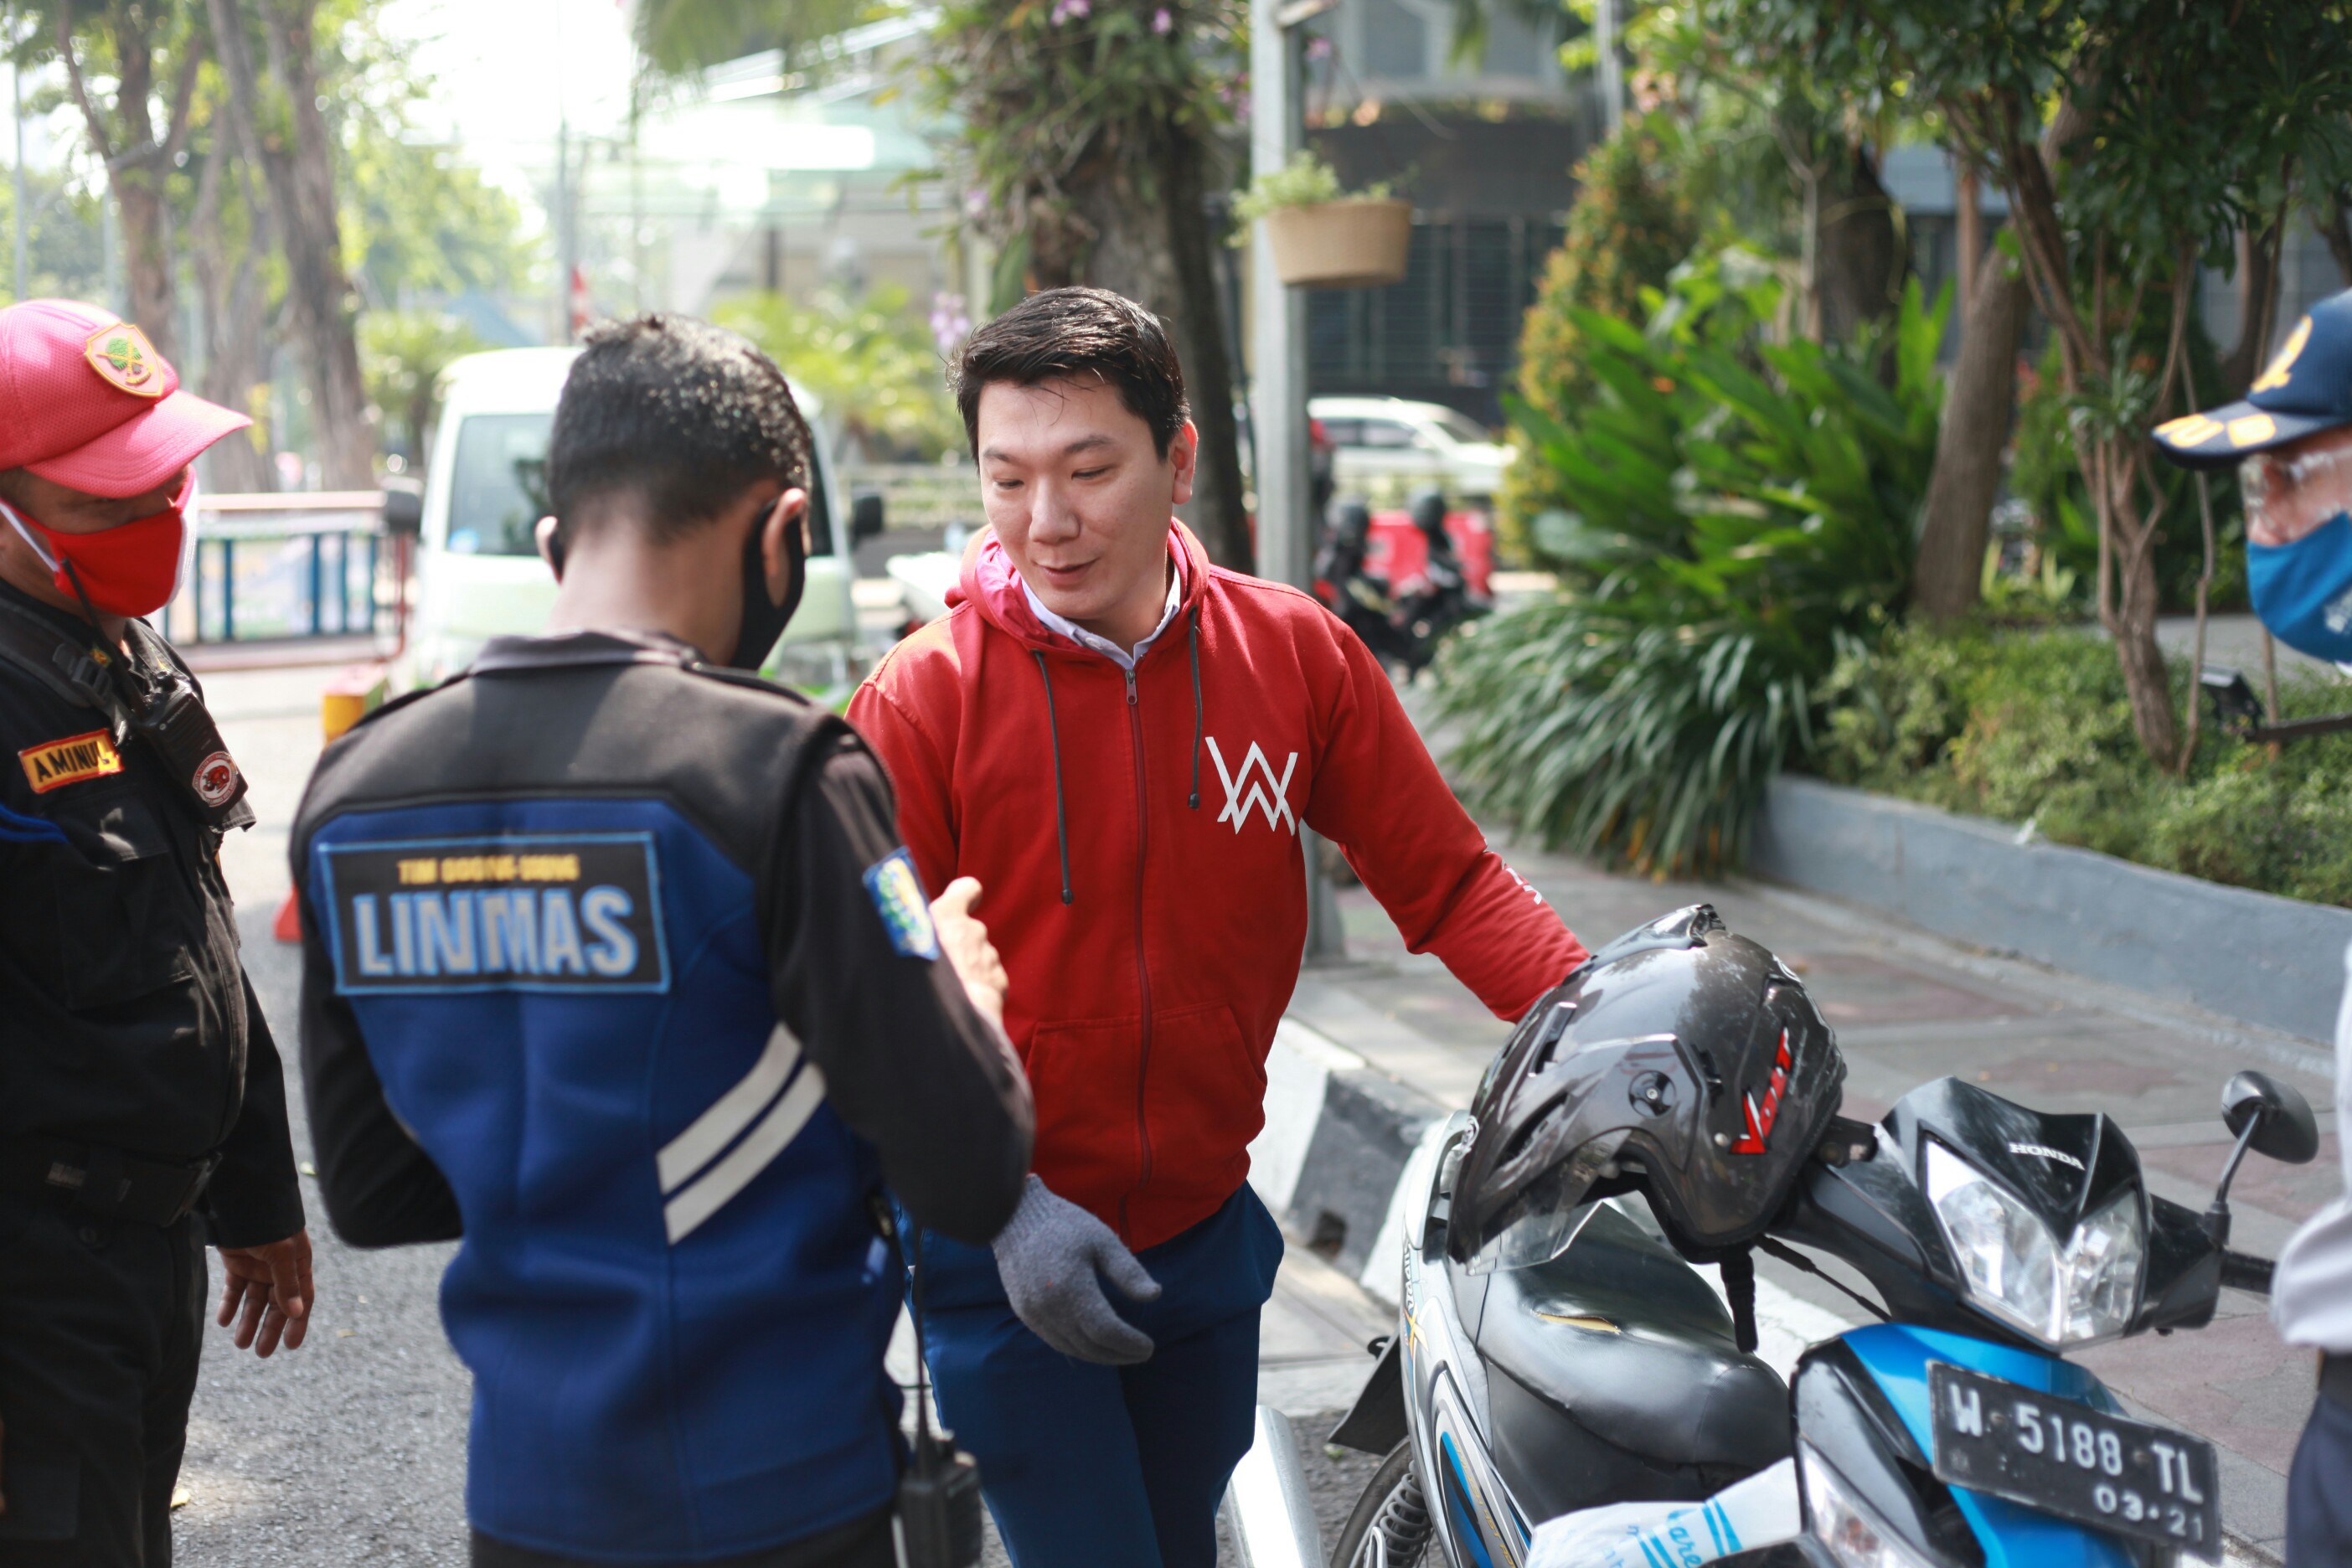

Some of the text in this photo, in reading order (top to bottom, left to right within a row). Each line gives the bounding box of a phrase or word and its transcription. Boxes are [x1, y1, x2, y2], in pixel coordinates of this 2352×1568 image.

[352, 885, 639, 977] LINMAS
[2009, 1142, 2086, 1172] HONDA
[1948, 1382, 1983, 1437] W
[2014, 1401, 2123, 1477] 5188
[2150, 1441, 2204, 1505] TL
